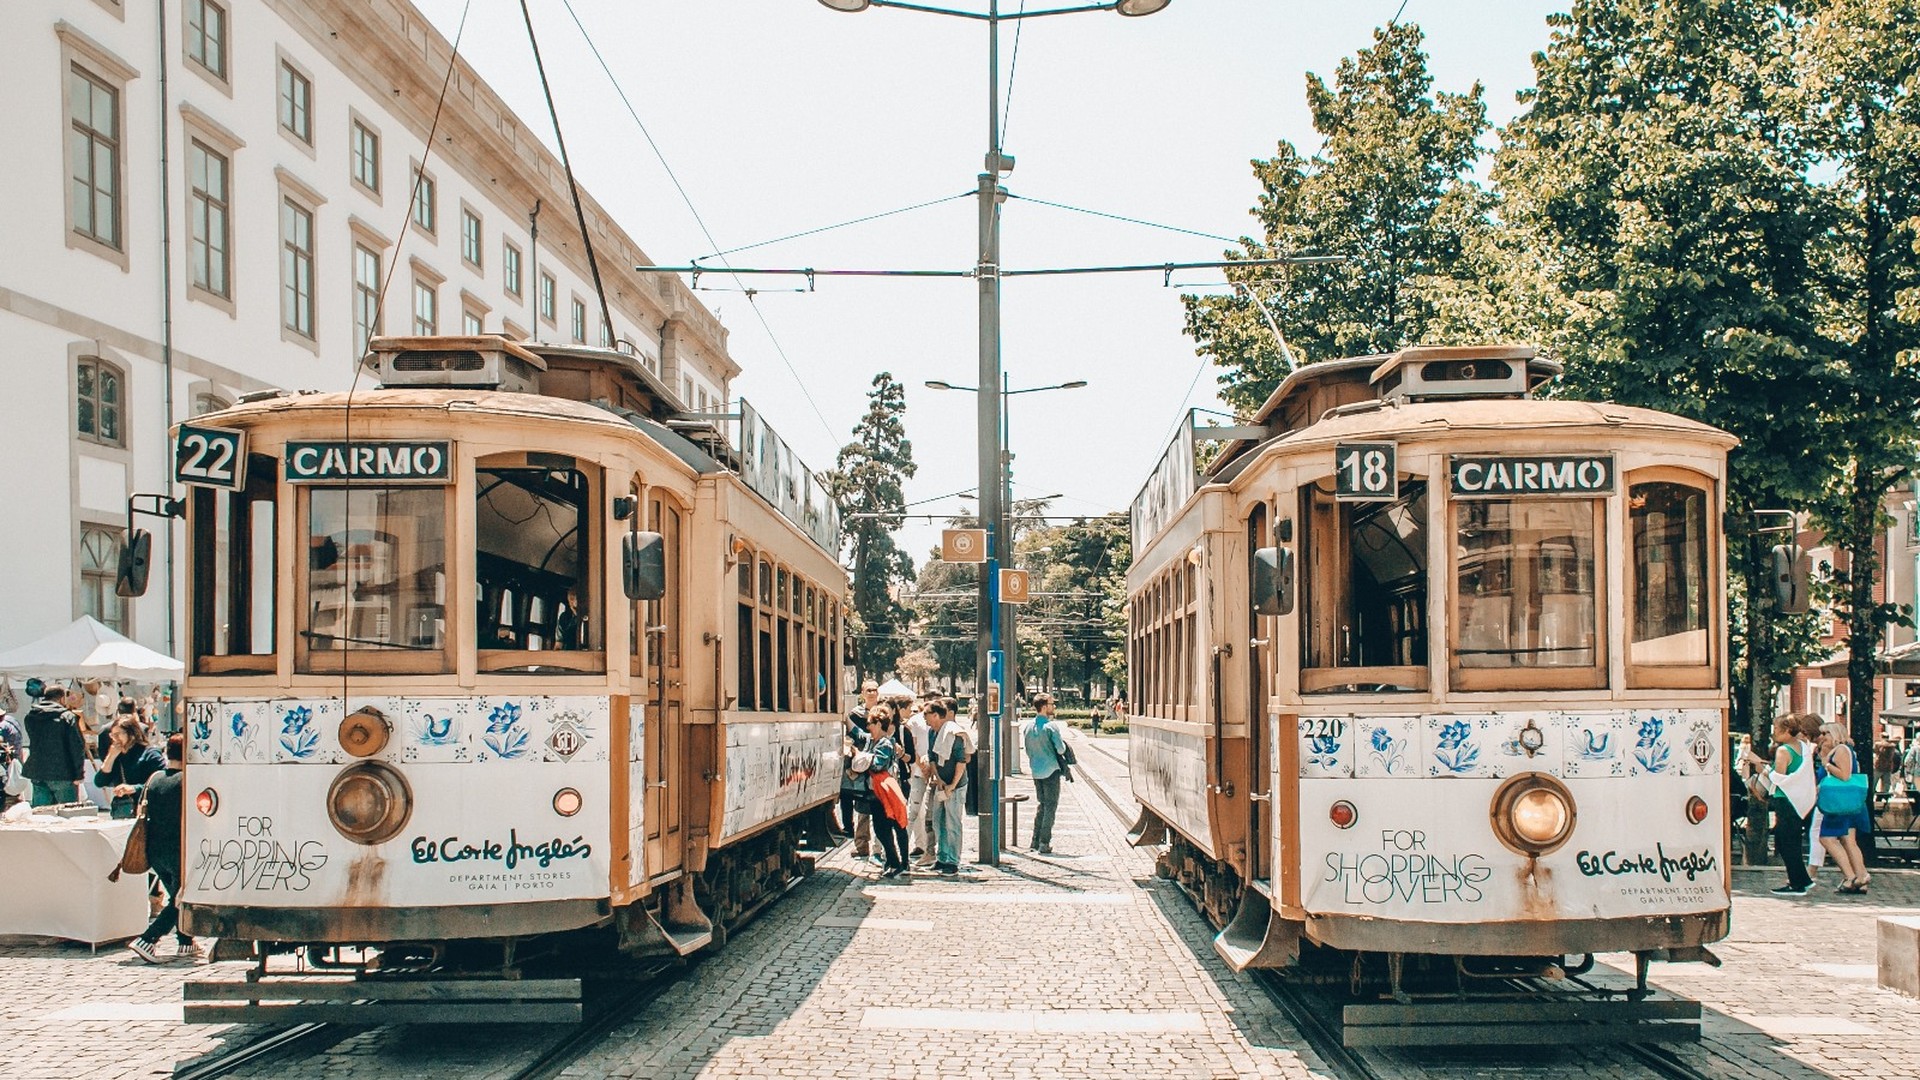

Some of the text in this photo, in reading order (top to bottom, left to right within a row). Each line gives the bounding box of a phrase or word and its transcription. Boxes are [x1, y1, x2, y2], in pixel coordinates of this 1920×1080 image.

[181, 434, 234, 480] 22
[294, 447, 442, 476] CARMO
[1343, 450, 1388, 492] 18
[1457, 460, 1606, 491] CARMO
[189, 702, 213, 723] 218
[1303, 718, 1343, 738] 220
[238, 816, 272, 836] FOR
[195, 838, 328, 870] SHOPPING
[411, 828, 591, 870] El Corte Inglés
[1382, 830, 1426, 851] FOR
[198, 861, 316, 891] LOVERS
[1325, 852, 1491, 883] SHOPPING
[1576, 850, 1604, 876] El
[1603, 850, 1658, 875] Corte
[450, 872, 571, 882] DEPARTMENT STORES
[468, 882, 497, 891] GAIA
[515, 881, 554, 890] PORTO
[1345, 873, 1483, 904] LOVERS
[1621, 886, 1714, 896] DEPARTMENT STORES
[1640, 896, 1665, 905] GAIA
[1678, 895, 1704, 904] PORTO
